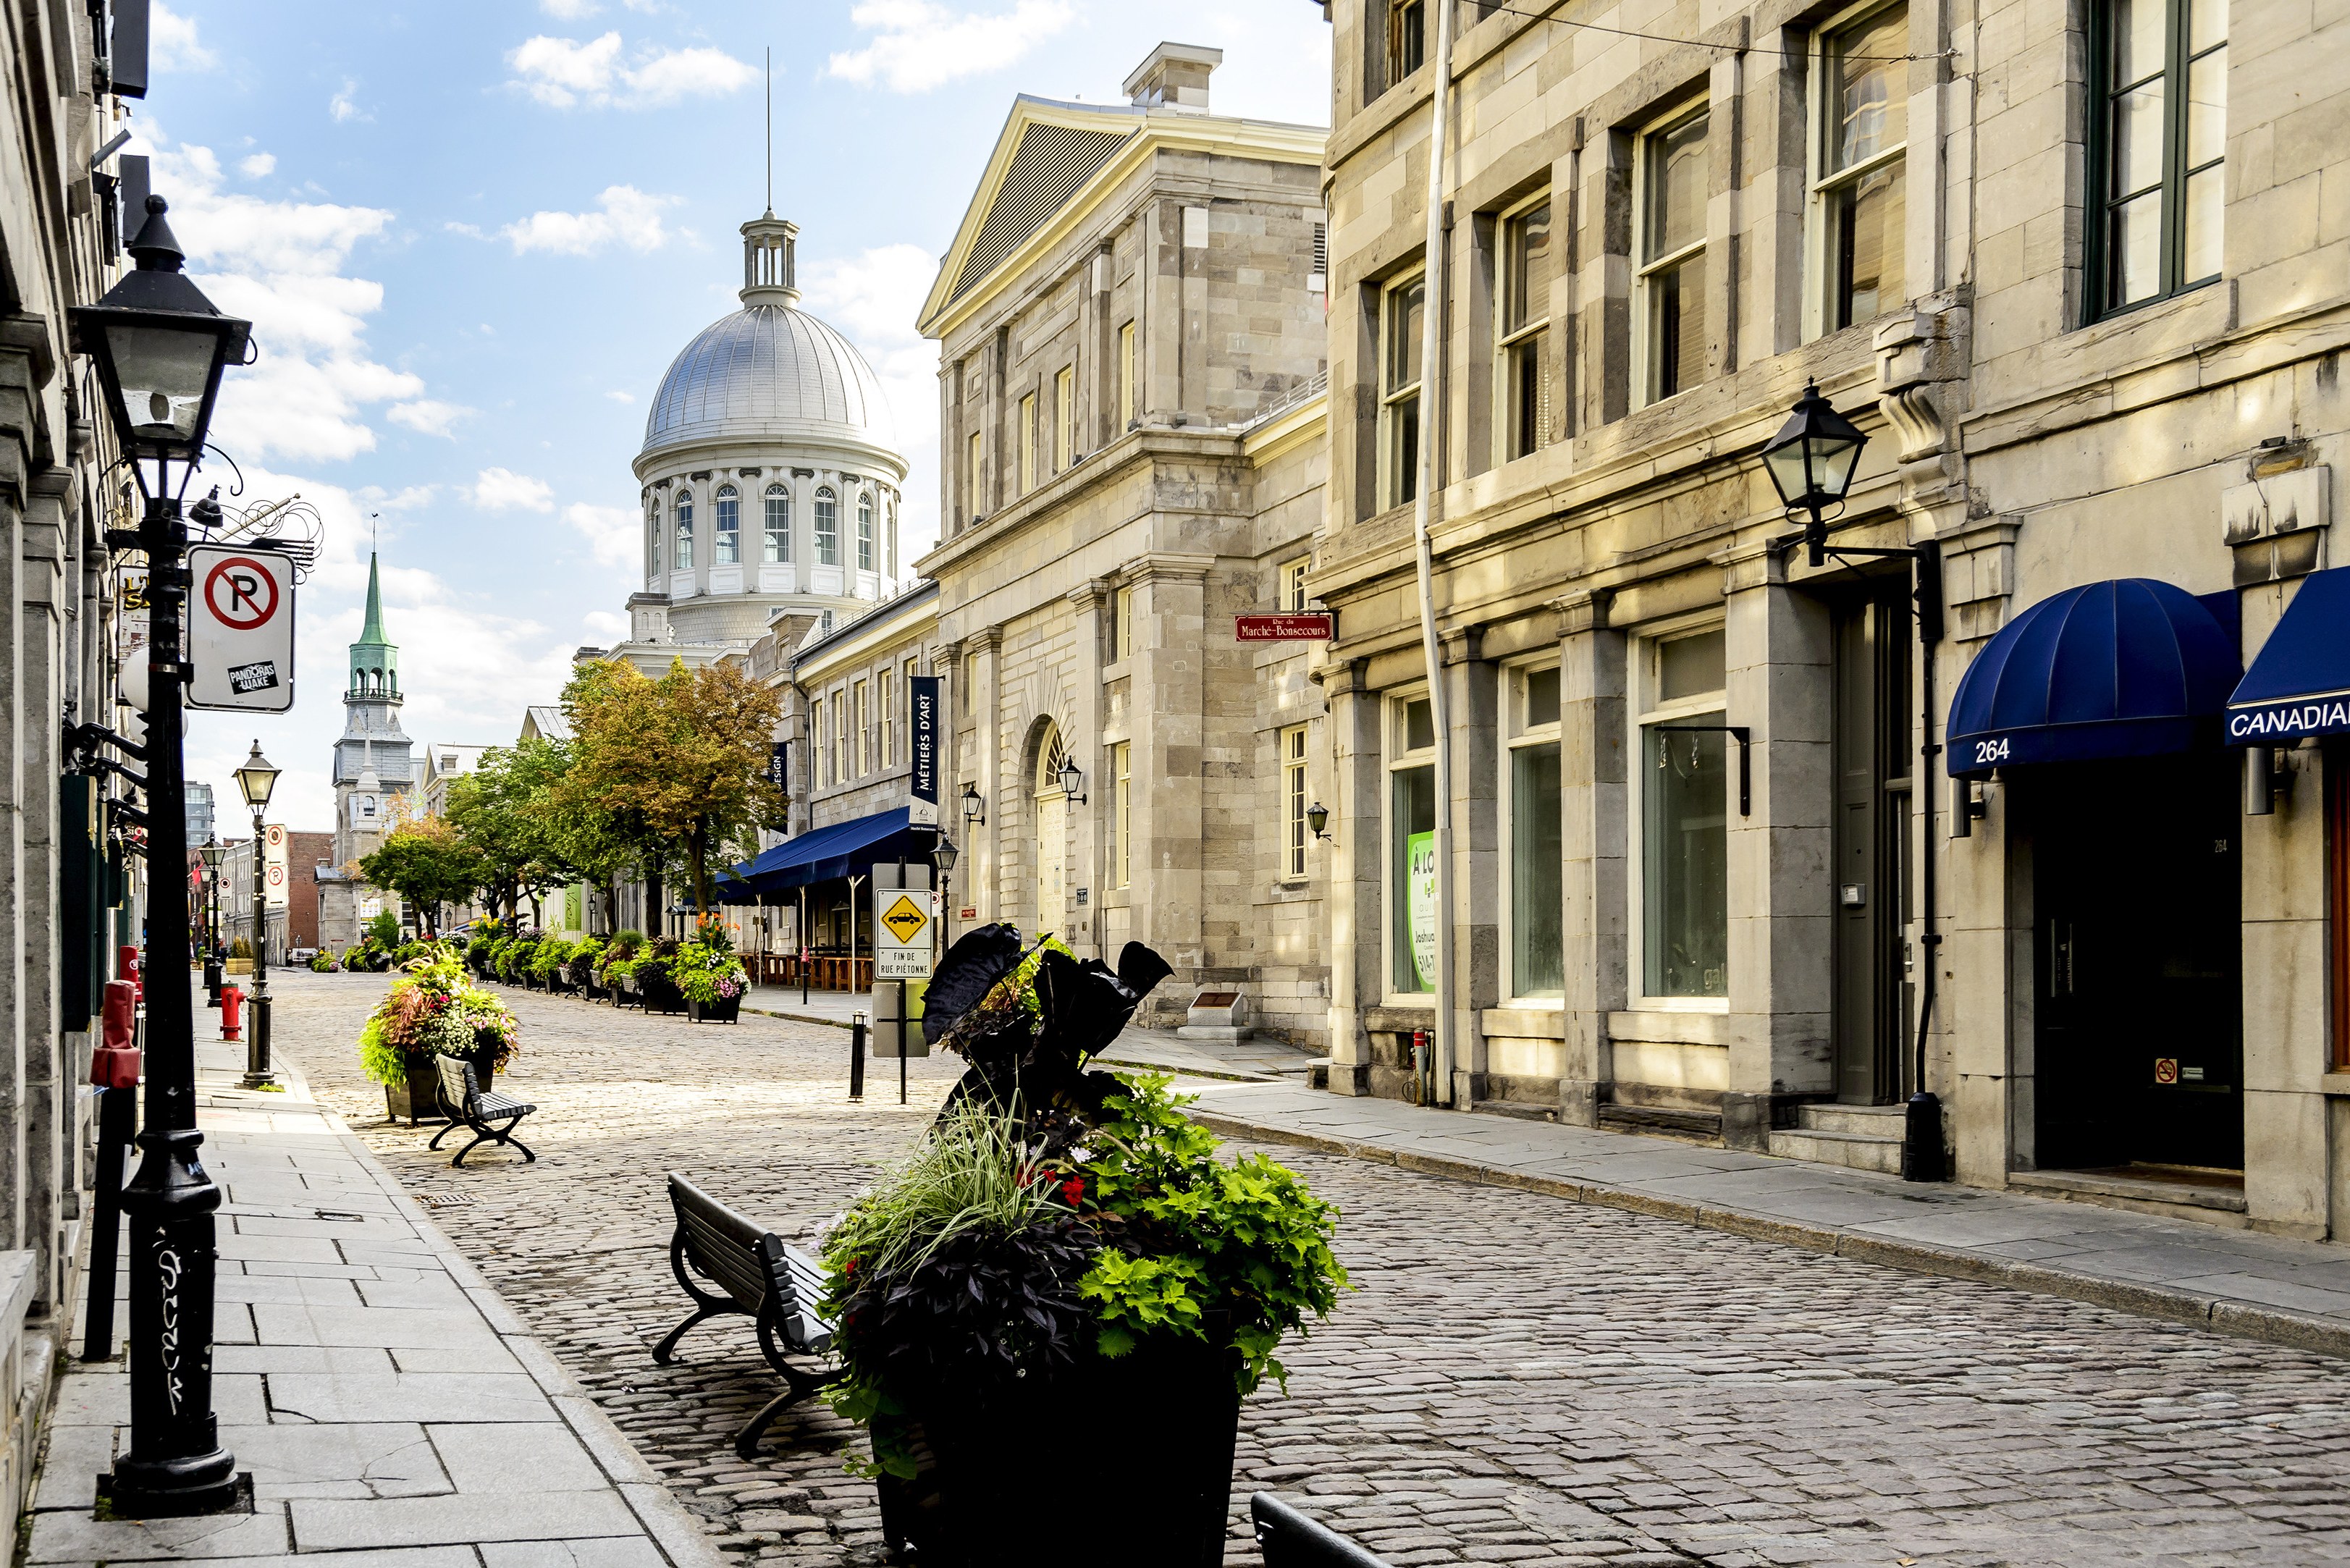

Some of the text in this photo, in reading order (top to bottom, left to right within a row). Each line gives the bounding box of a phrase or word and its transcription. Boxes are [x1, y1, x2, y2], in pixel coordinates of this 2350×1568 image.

[1242, 625, 1326, 636] Marché-Bonsecours
[239, 675, 270, 690] WAKE
[917, 694, 930, 791] MÉTIERS D'ART
[1975, 737, 2010, 764] 264
[2215, 839, 2228, 853] 264
[1412, 846, 1435, 876] À LO
[893, 952, 915, 961] FIN DE
[1418, 954, 1436, 972] 514-7
[880, 964, 894, 974] RUE
